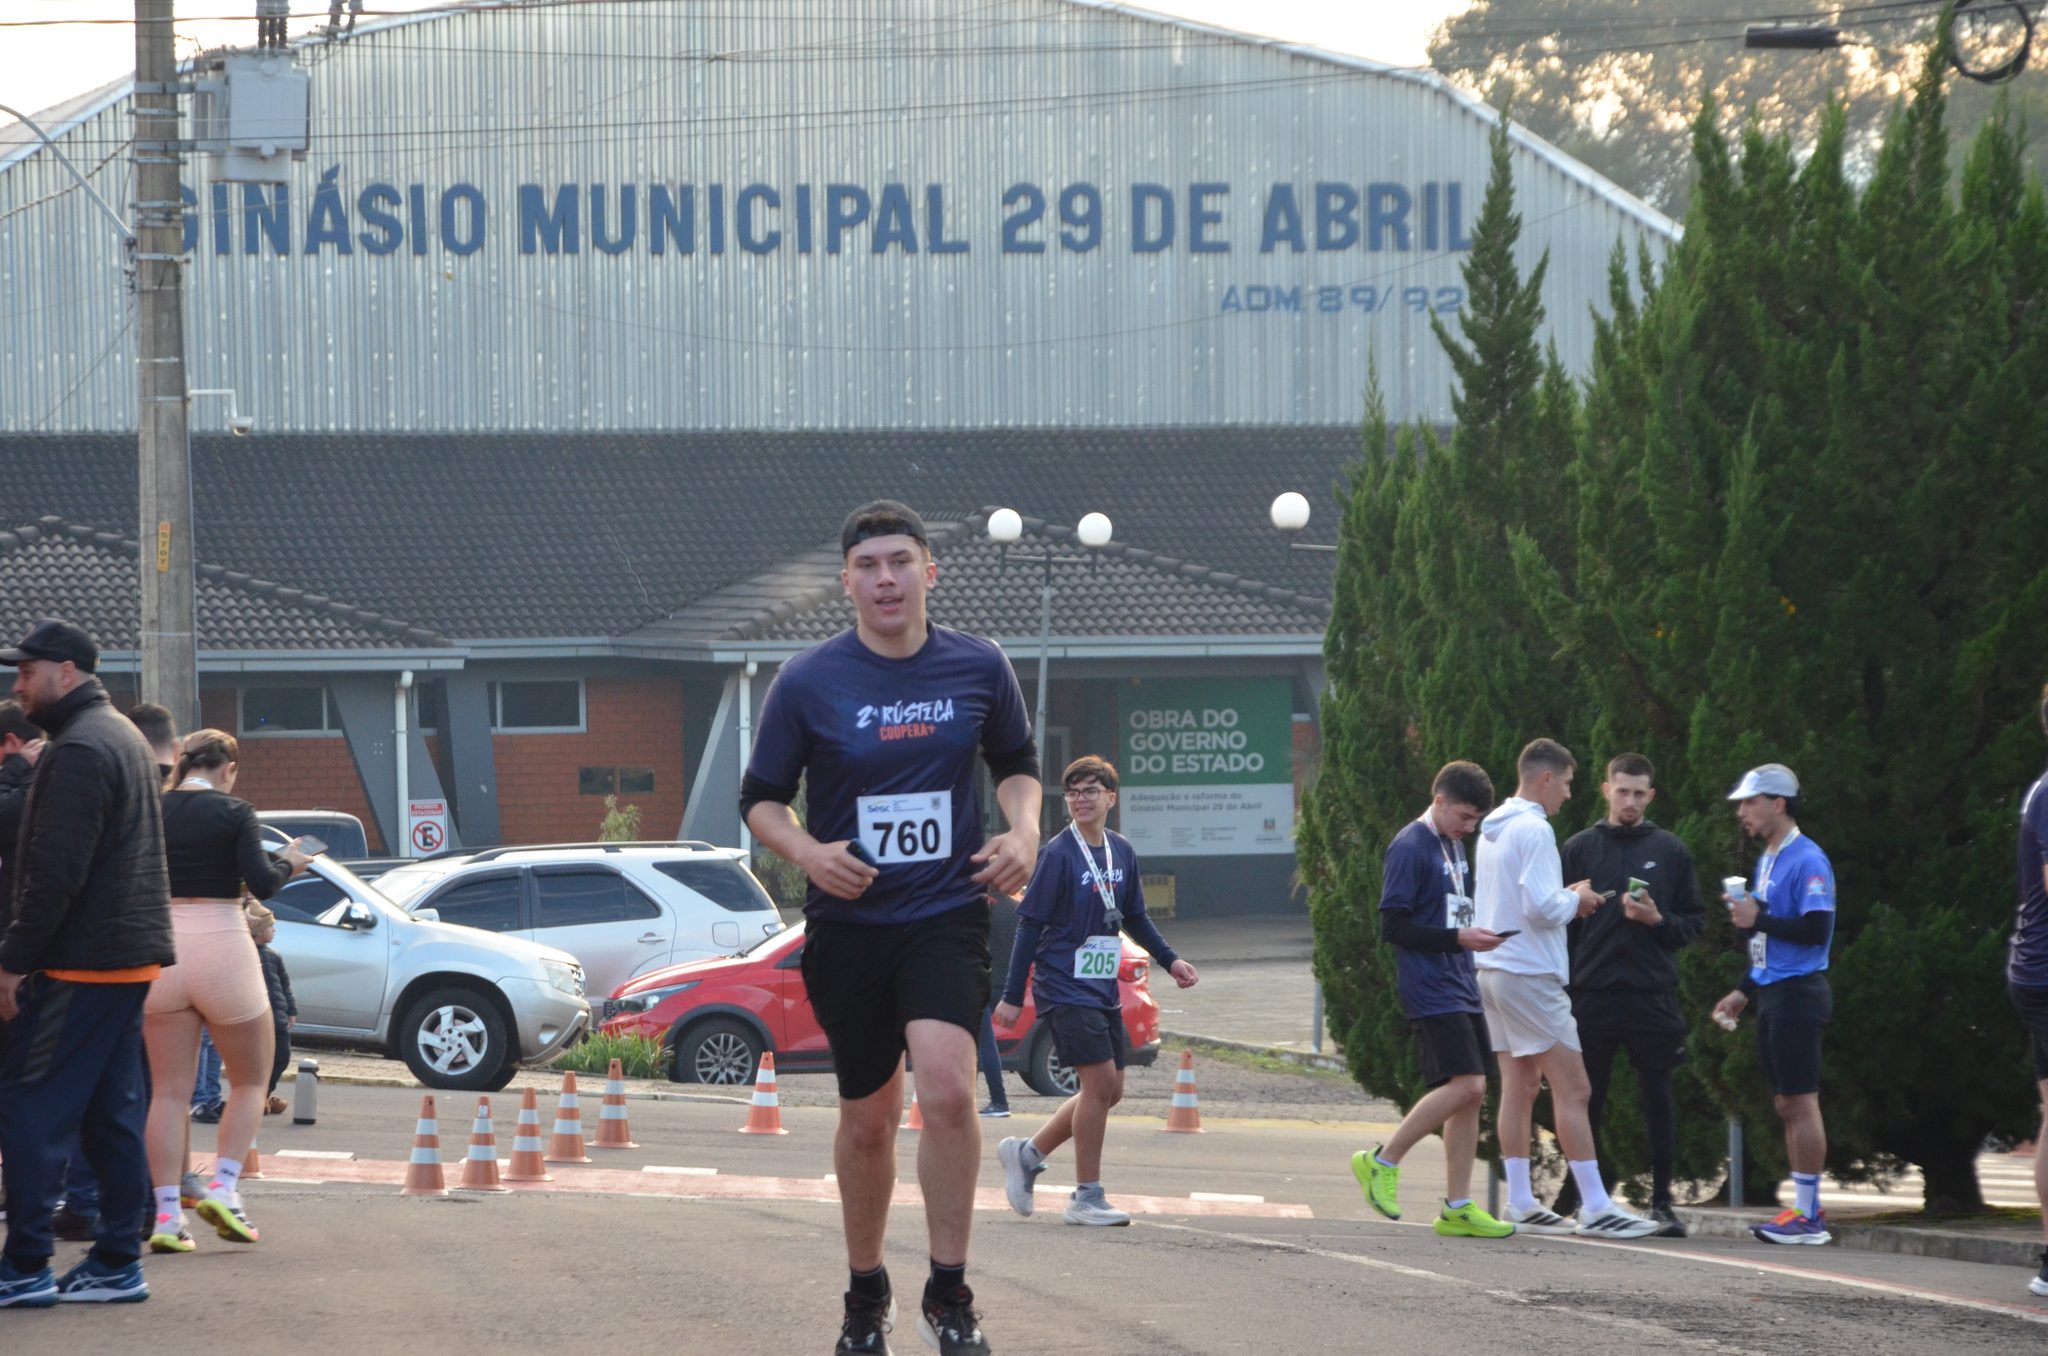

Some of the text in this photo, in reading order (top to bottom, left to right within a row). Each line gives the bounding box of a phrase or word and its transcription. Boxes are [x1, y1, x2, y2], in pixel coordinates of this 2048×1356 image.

[518, 183, 970, 255] MUNICIPAL
[1002, 182, 1102, 253] 29
[1131, 183, 1230, 253] DE
[1260, 182, 1473, 253] ABRIL
[882, 698, 954, 726] RÚSTICA
[1129, 708, 1239, 729] OBRA DO
[1129, 730, 1248, 751] GOVERNO
[1130, 752, 1265, 774] DO ESTADO
[1130, 792, 1181, 803] Adequação
[1192, 791, 1228, 801] reforma
[1230, 791, 1242, 800] do
[1130, 803, 1164, 813] Ginásio
[1167, 803, 1210, 813] Municipal
[1226, 802, 1237, 810] de
[1240, 801, 1263, 810] Abril
[873, 818, 940, 857] 760
[1081, 951, 1116, 975] 205
